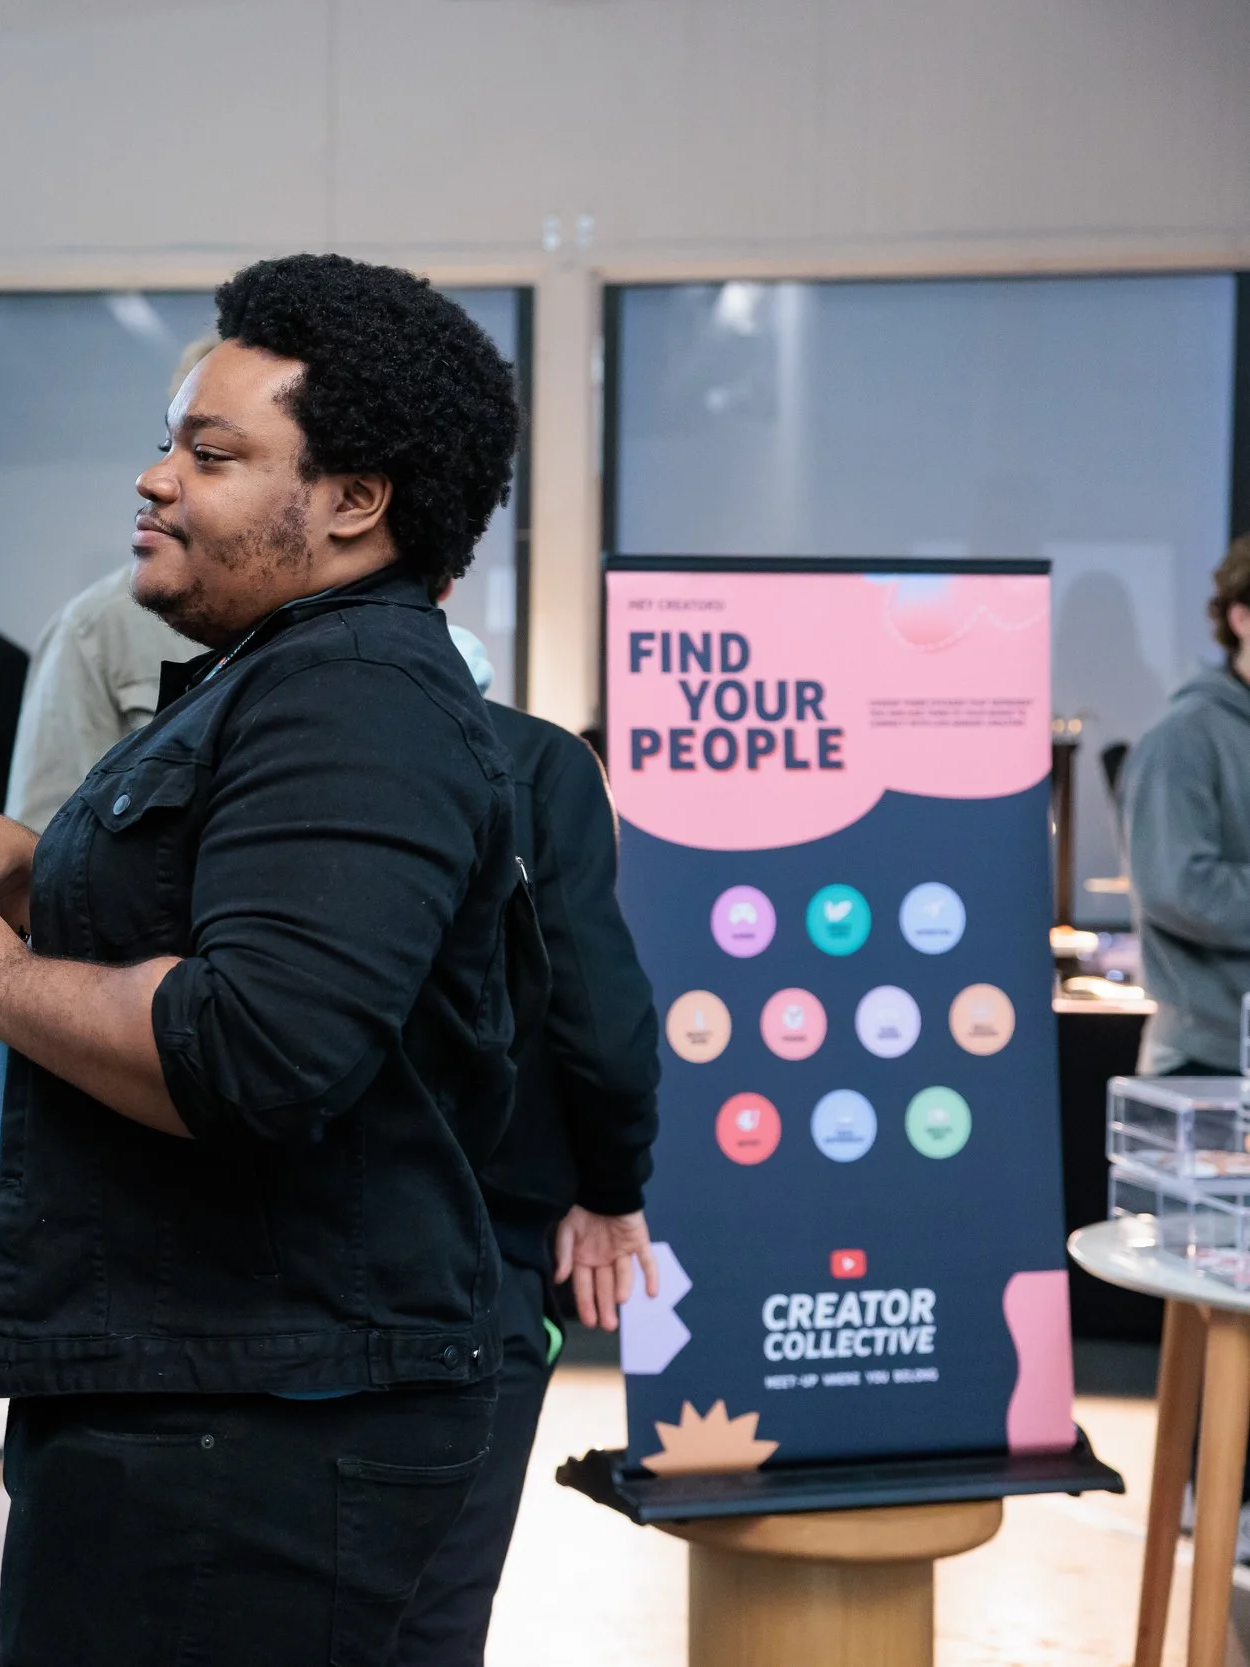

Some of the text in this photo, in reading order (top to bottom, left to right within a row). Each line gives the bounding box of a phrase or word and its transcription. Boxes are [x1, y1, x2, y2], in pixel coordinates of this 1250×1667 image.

[629, 631, 751, 674] FIND
[678, 679, 827, 722] YOUR
[630, 727, 846, 772] PEOPLE
[762, 1287, 936, 1332] CREATOR
[763, 1325, 937, 1361] COLLECTIVE
